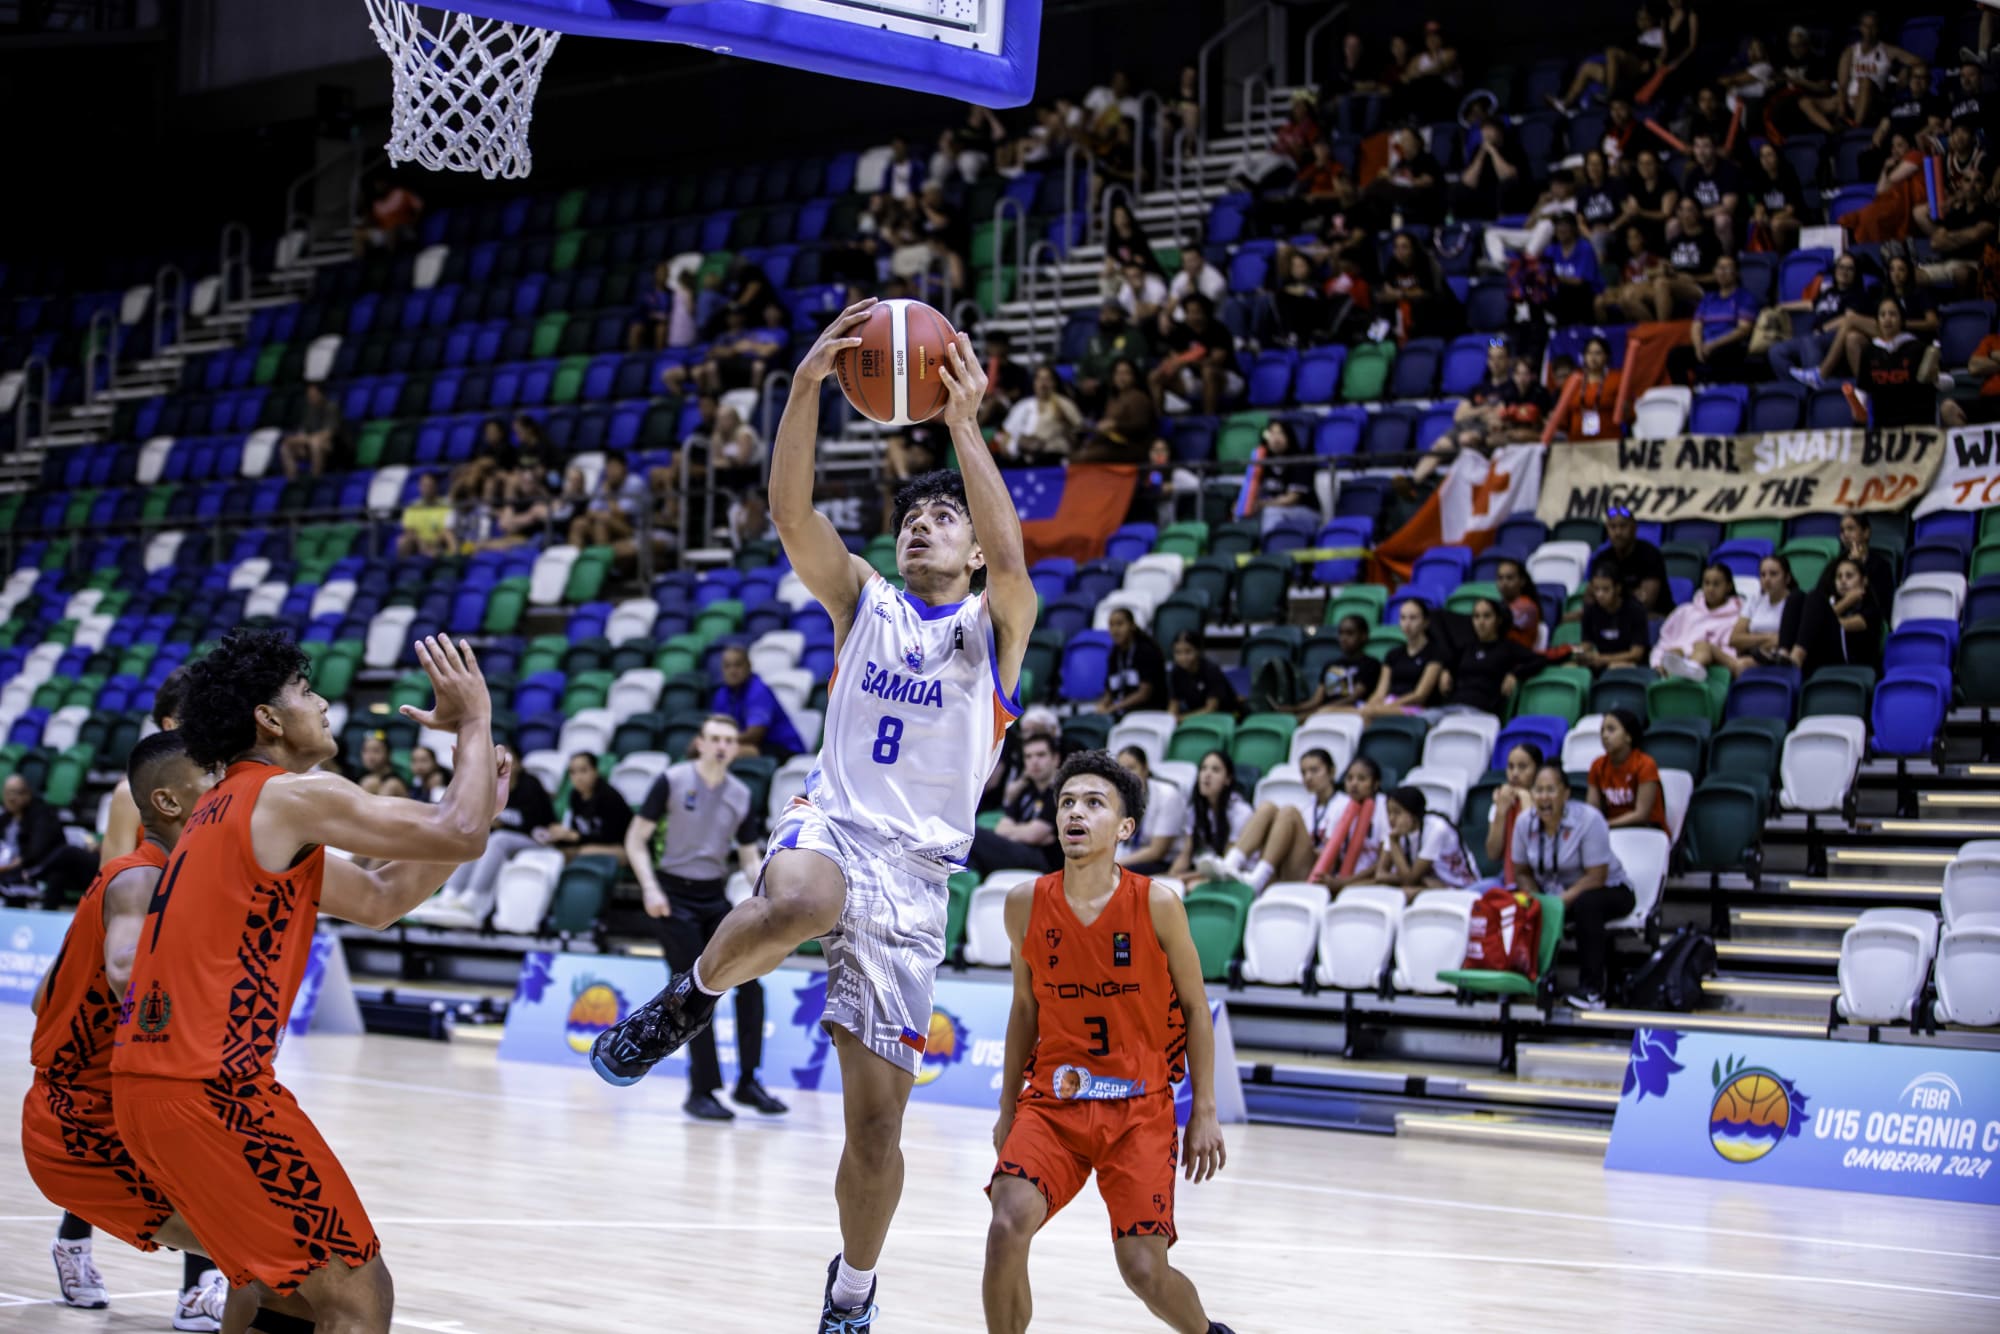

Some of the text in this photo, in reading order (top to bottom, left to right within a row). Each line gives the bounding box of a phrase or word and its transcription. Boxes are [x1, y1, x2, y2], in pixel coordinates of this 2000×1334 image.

[861, 349, 873, 378] FIBA
[1617, 438, 1662, 471] WE
[1675, 438, 1740, 474] ARE
[1862, 428, 1938, 465] BUT
[1954, 430, 2000, 467] W
[1567, 483, 1697, 519] MIGHTY
[1704, 485, 1750, 513] IN
[1754, 477, 1820, 509] THE
[861, 661, 943, 708] SAMOA
[872, 715, 904, 765] 8
[148, 850, 188, 954] 4
[1043, 981, 1142, 1000] TONGA
[1084, 1016, 1110, 1057] 3
[1094, 1081, 1128, 1093] nena
[1911, 1087, 1950, 1111] FIBA
[1814, 1108, 1861, 1140] U15
[1865, 1112, 1978, 1151] OCEANIA
[1842, 1147, 1993, 1179] CANBERRA 2024
